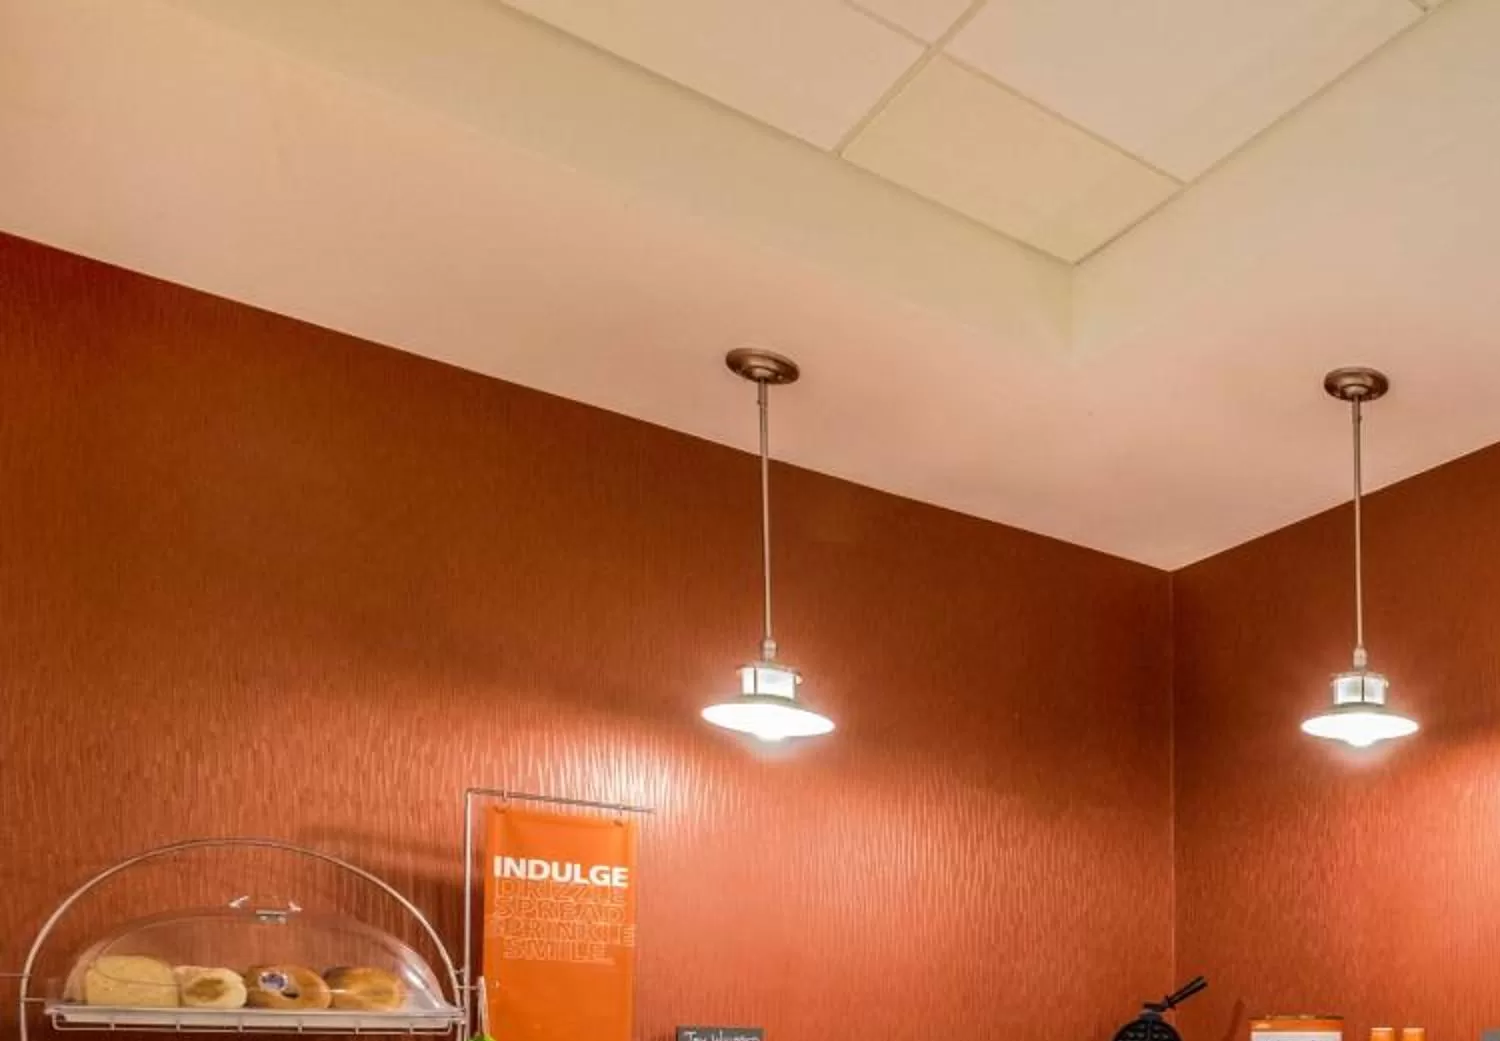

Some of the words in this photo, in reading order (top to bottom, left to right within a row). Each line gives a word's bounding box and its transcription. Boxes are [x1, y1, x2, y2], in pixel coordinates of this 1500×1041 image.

[493, 855, 629, 888] INDULGE
[496, 879, 625, 907] DRIZZLE
[495, 897, 626, 924] SPREAD
